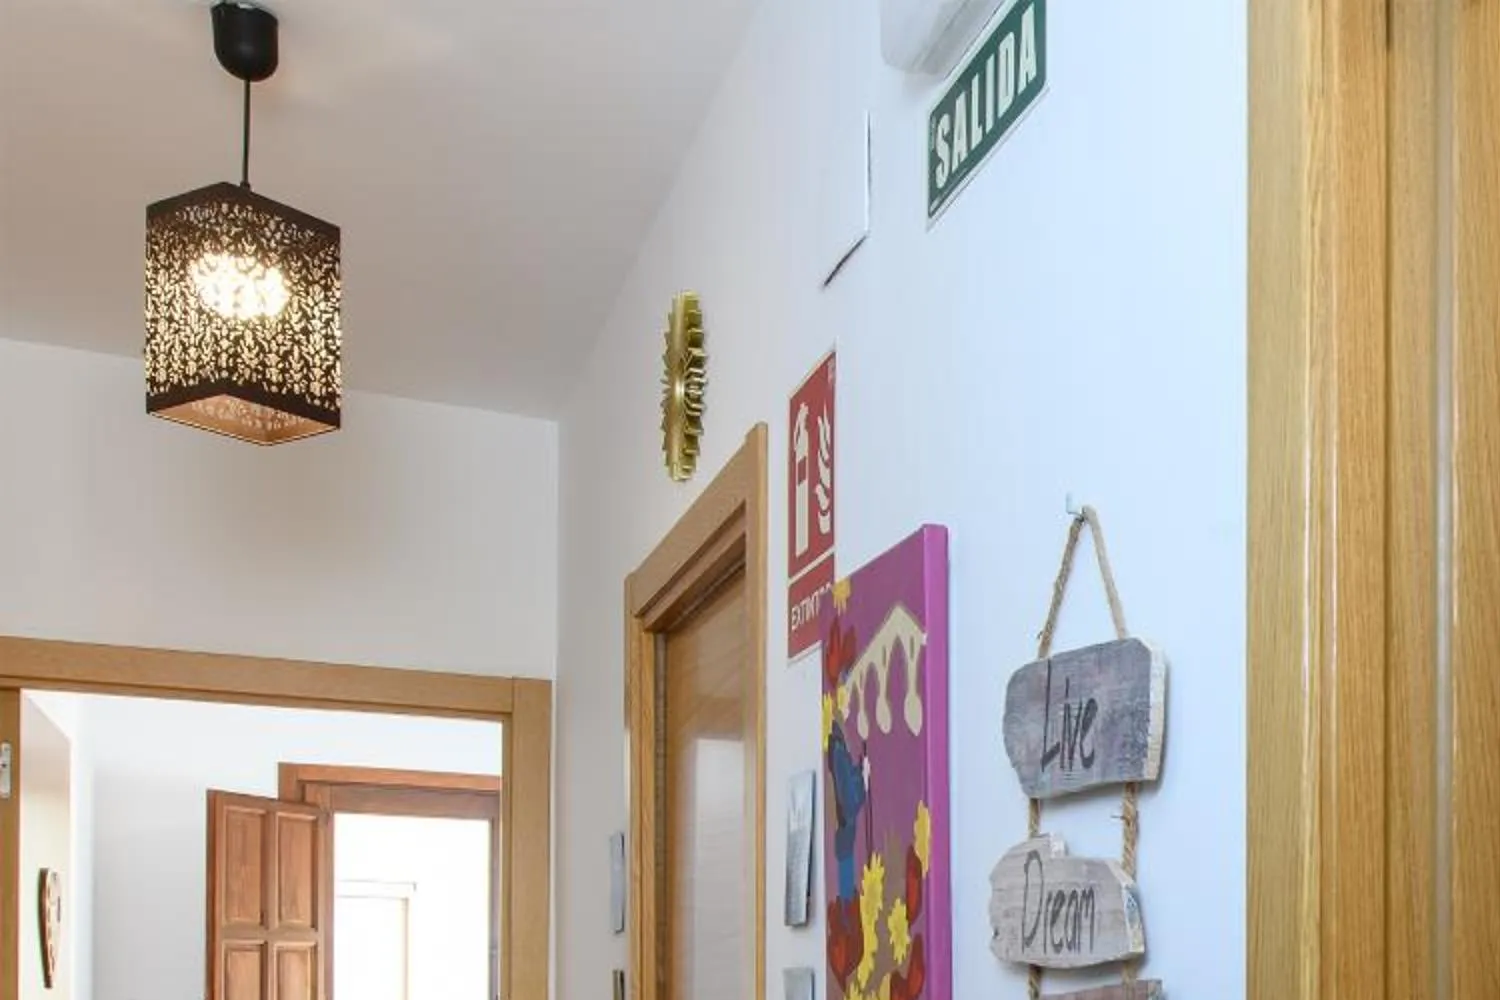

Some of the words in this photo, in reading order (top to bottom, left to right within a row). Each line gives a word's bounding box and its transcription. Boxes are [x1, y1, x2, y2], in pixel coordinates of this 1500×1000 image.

[935, 2, 1038, 190] SALIDA
[791, 582, 832, 631] EXTINT
[1040, 660, 1097, 773] Live
[1020, 849, 1095, 956] Dream
